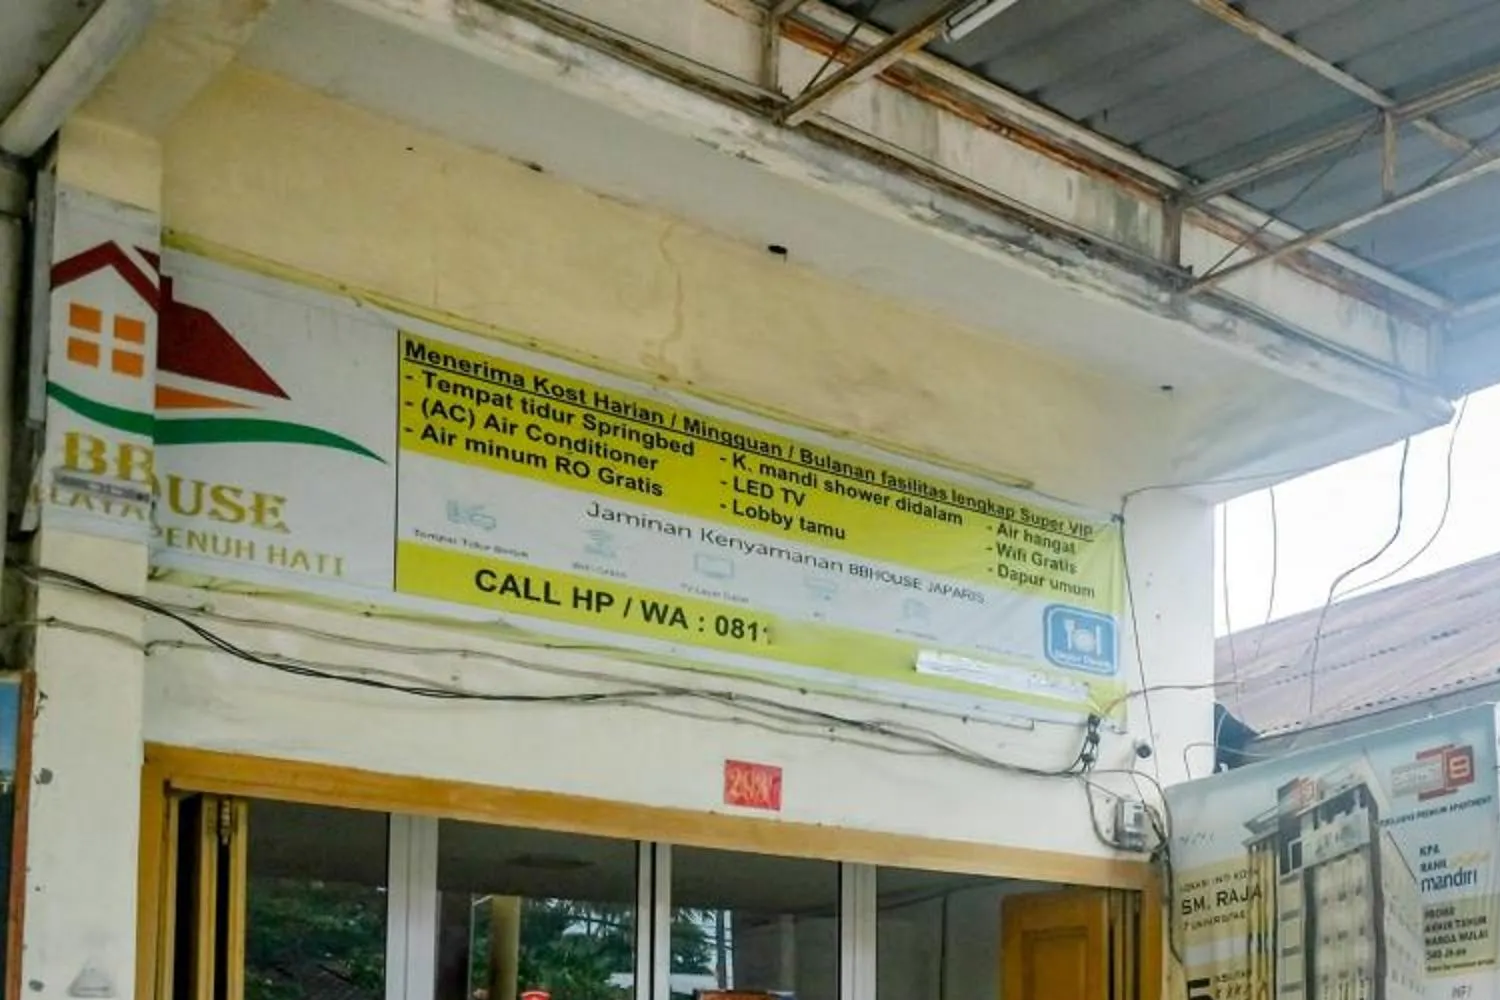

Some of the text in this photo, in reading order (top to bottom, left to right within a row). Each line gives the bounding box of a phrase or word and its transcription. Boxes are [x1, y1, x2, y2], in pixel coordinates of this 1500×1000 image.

[421, 370, 515, 413] Tempat
[521, 396, 577, 426] tidur
[582, 413, 695, 458] Springbed
[404, 339, 526, 390] Menerima
[533, 370, 586, 406] Kost
[594, 393, 665, 426] Harian
[683, 414, 783, 459] Mingguan
[800, 447, 876, 483] Bulanan
[881, 470, 948, 502] fasilitas
[951, 486, 1016, 522] lengkap
[1020, 504, 1066, 535] Super
[1067, 518, 1094, 539] VIP
[421, 396, 476, 430] (AC)
[483, 412, 519, 438] Air
[525, 422, 659, 472] Conditioner
[420, 422, 458, 447] Air
[465, 435, 548, 470] minum
[554, 455, 591, 479] RO
[597, 466, 664, 498] Gratis
[732, 452, 753, 473] K.
[758, 460, 818, 490] mandi
[823, 476, 891, 508] shower
[895, 495, 964, 527] didalam
[732, 477, 775, 502] LED
[779, 486, 807, 508] TV
[732, 502, 794, 532] Lobby
[799, 515, 847, 541] tamu
[996, 522, 1019, 543] Air
[1022, 527, 1078, 557] hangat
[267, 542, 345, 578] HATI
[586, 500, 986, 606] Jaminan Kenyamanan BBHOUSE JAPARIS
[996, 542, 1029, 566] Wifi
[1031, 549, 1078, 576] Gratis
[474, 568, 562, 606] CALL
[572, 585, 615, 614] HP
[640, 599, 689, 631] WA
[996, 563, 1045, 591] Dapur
[1049, 577, 1096, 600] umum
[1216, 882, 1263, 908] RAJA
[1420, 867, 1478, 894] mandiri
